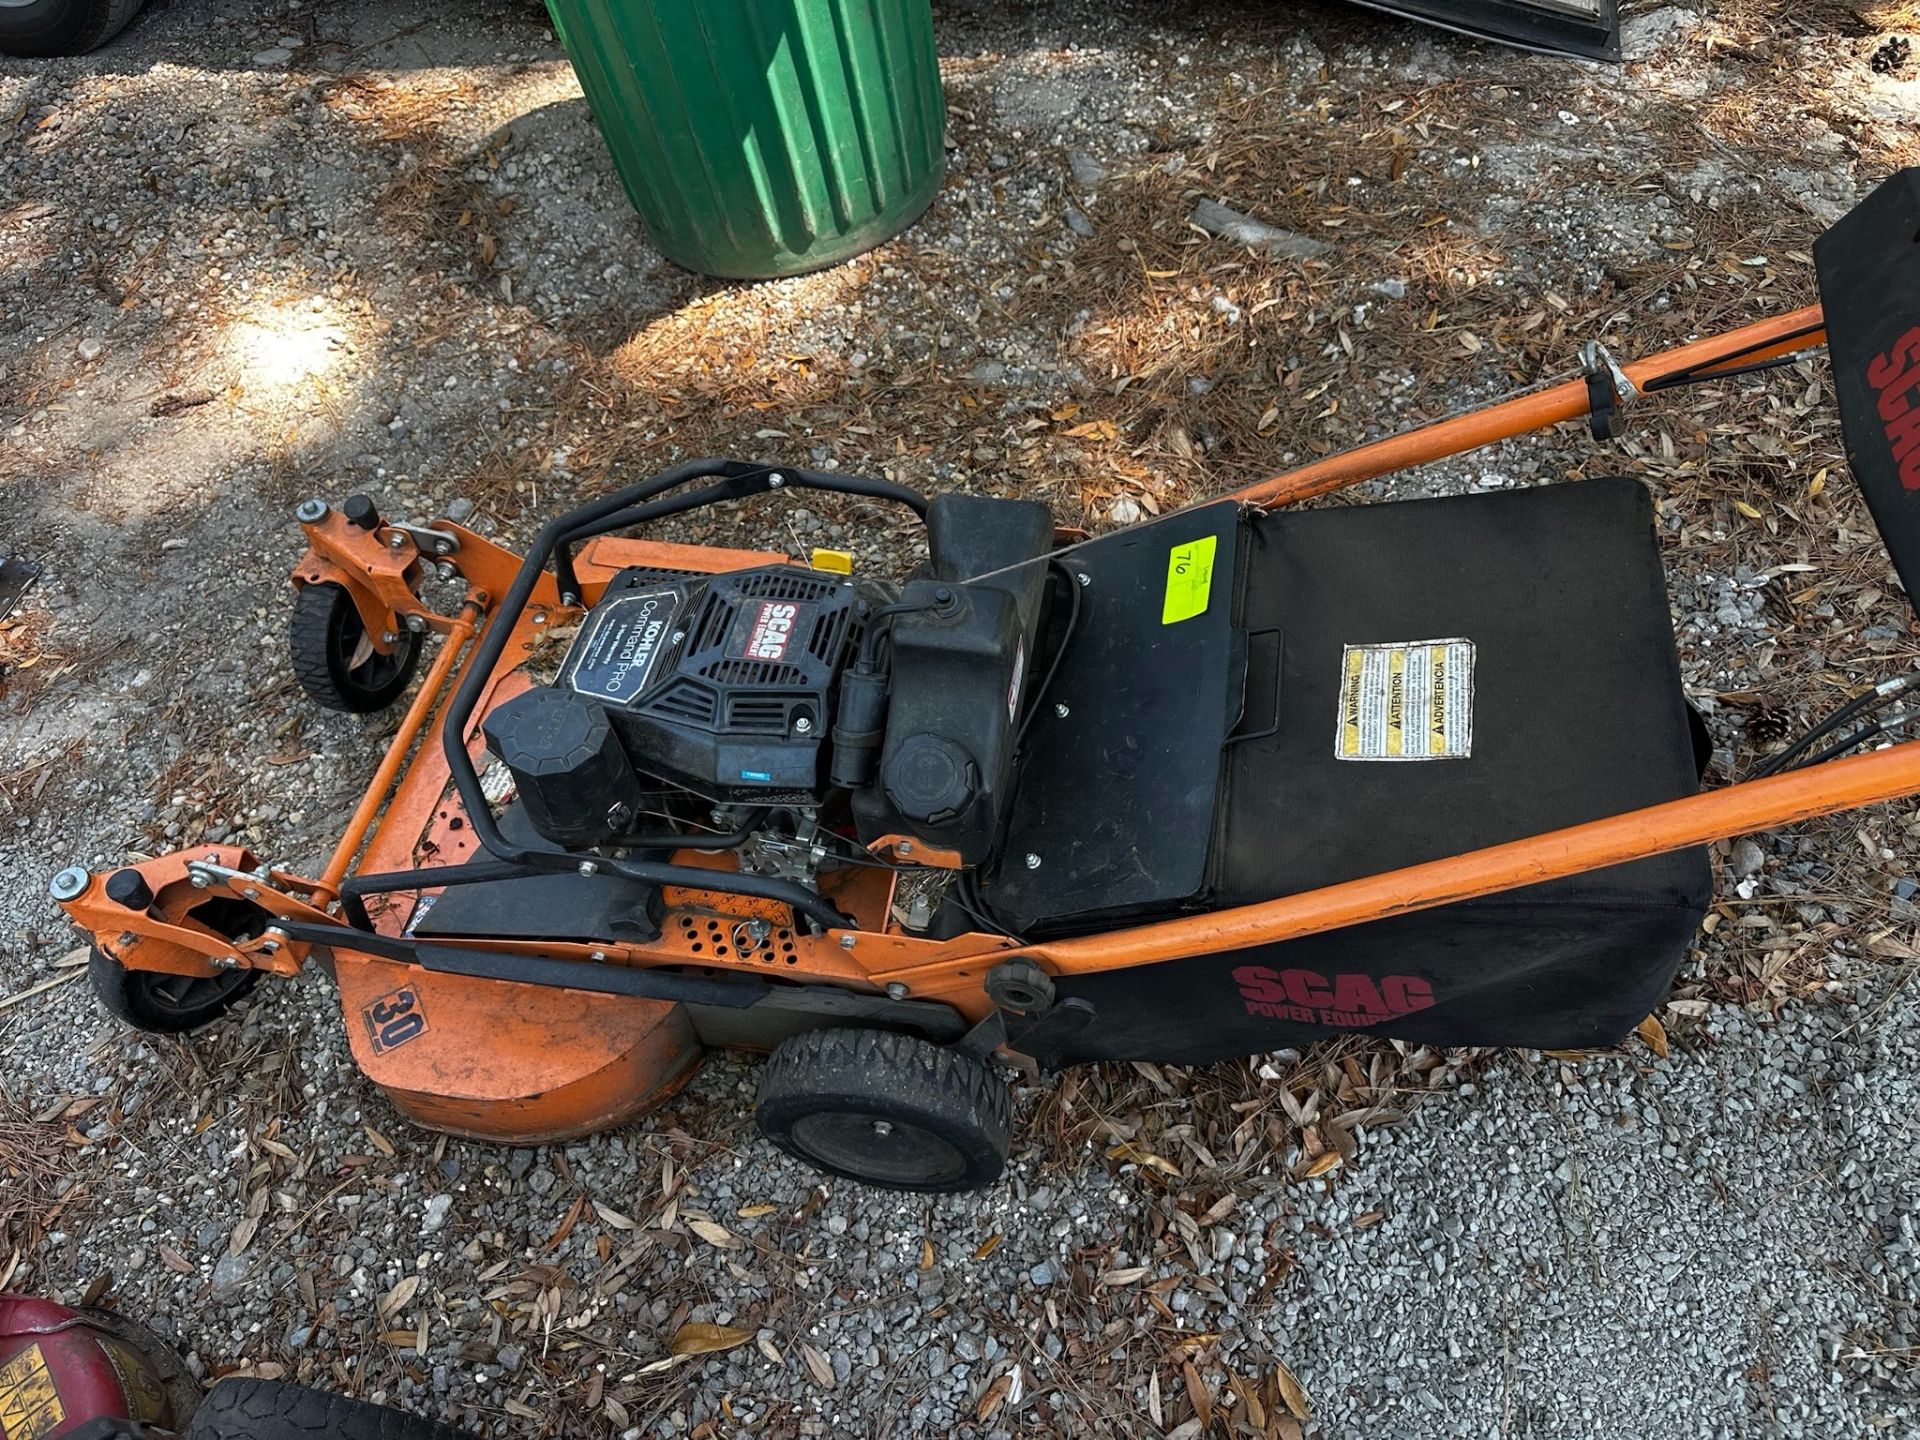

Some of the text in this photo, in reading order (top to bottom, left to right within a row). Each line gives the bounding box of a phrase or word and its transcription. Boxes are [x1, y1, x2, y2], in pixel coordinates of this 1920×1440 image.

[1176, 550, 1192, 575] 76
[758, 605, 796, 659] SCAG
[760, 604, 774, 623] POWER
[606, 601, 658, 692] Command PRO
[632, 621, 663, 667] KOHLER
[1349, 675, 1361, 715] WARNING
[1391, 672, 1402, 719] ATTENTION
[1437, 662, 1445, 723] ADVERTENCIA
[1232, 966, 1437, 1014] SCAG
[1244, 1001, 1316, 1024] POWER
[372, 991, 424, 1047] 30
